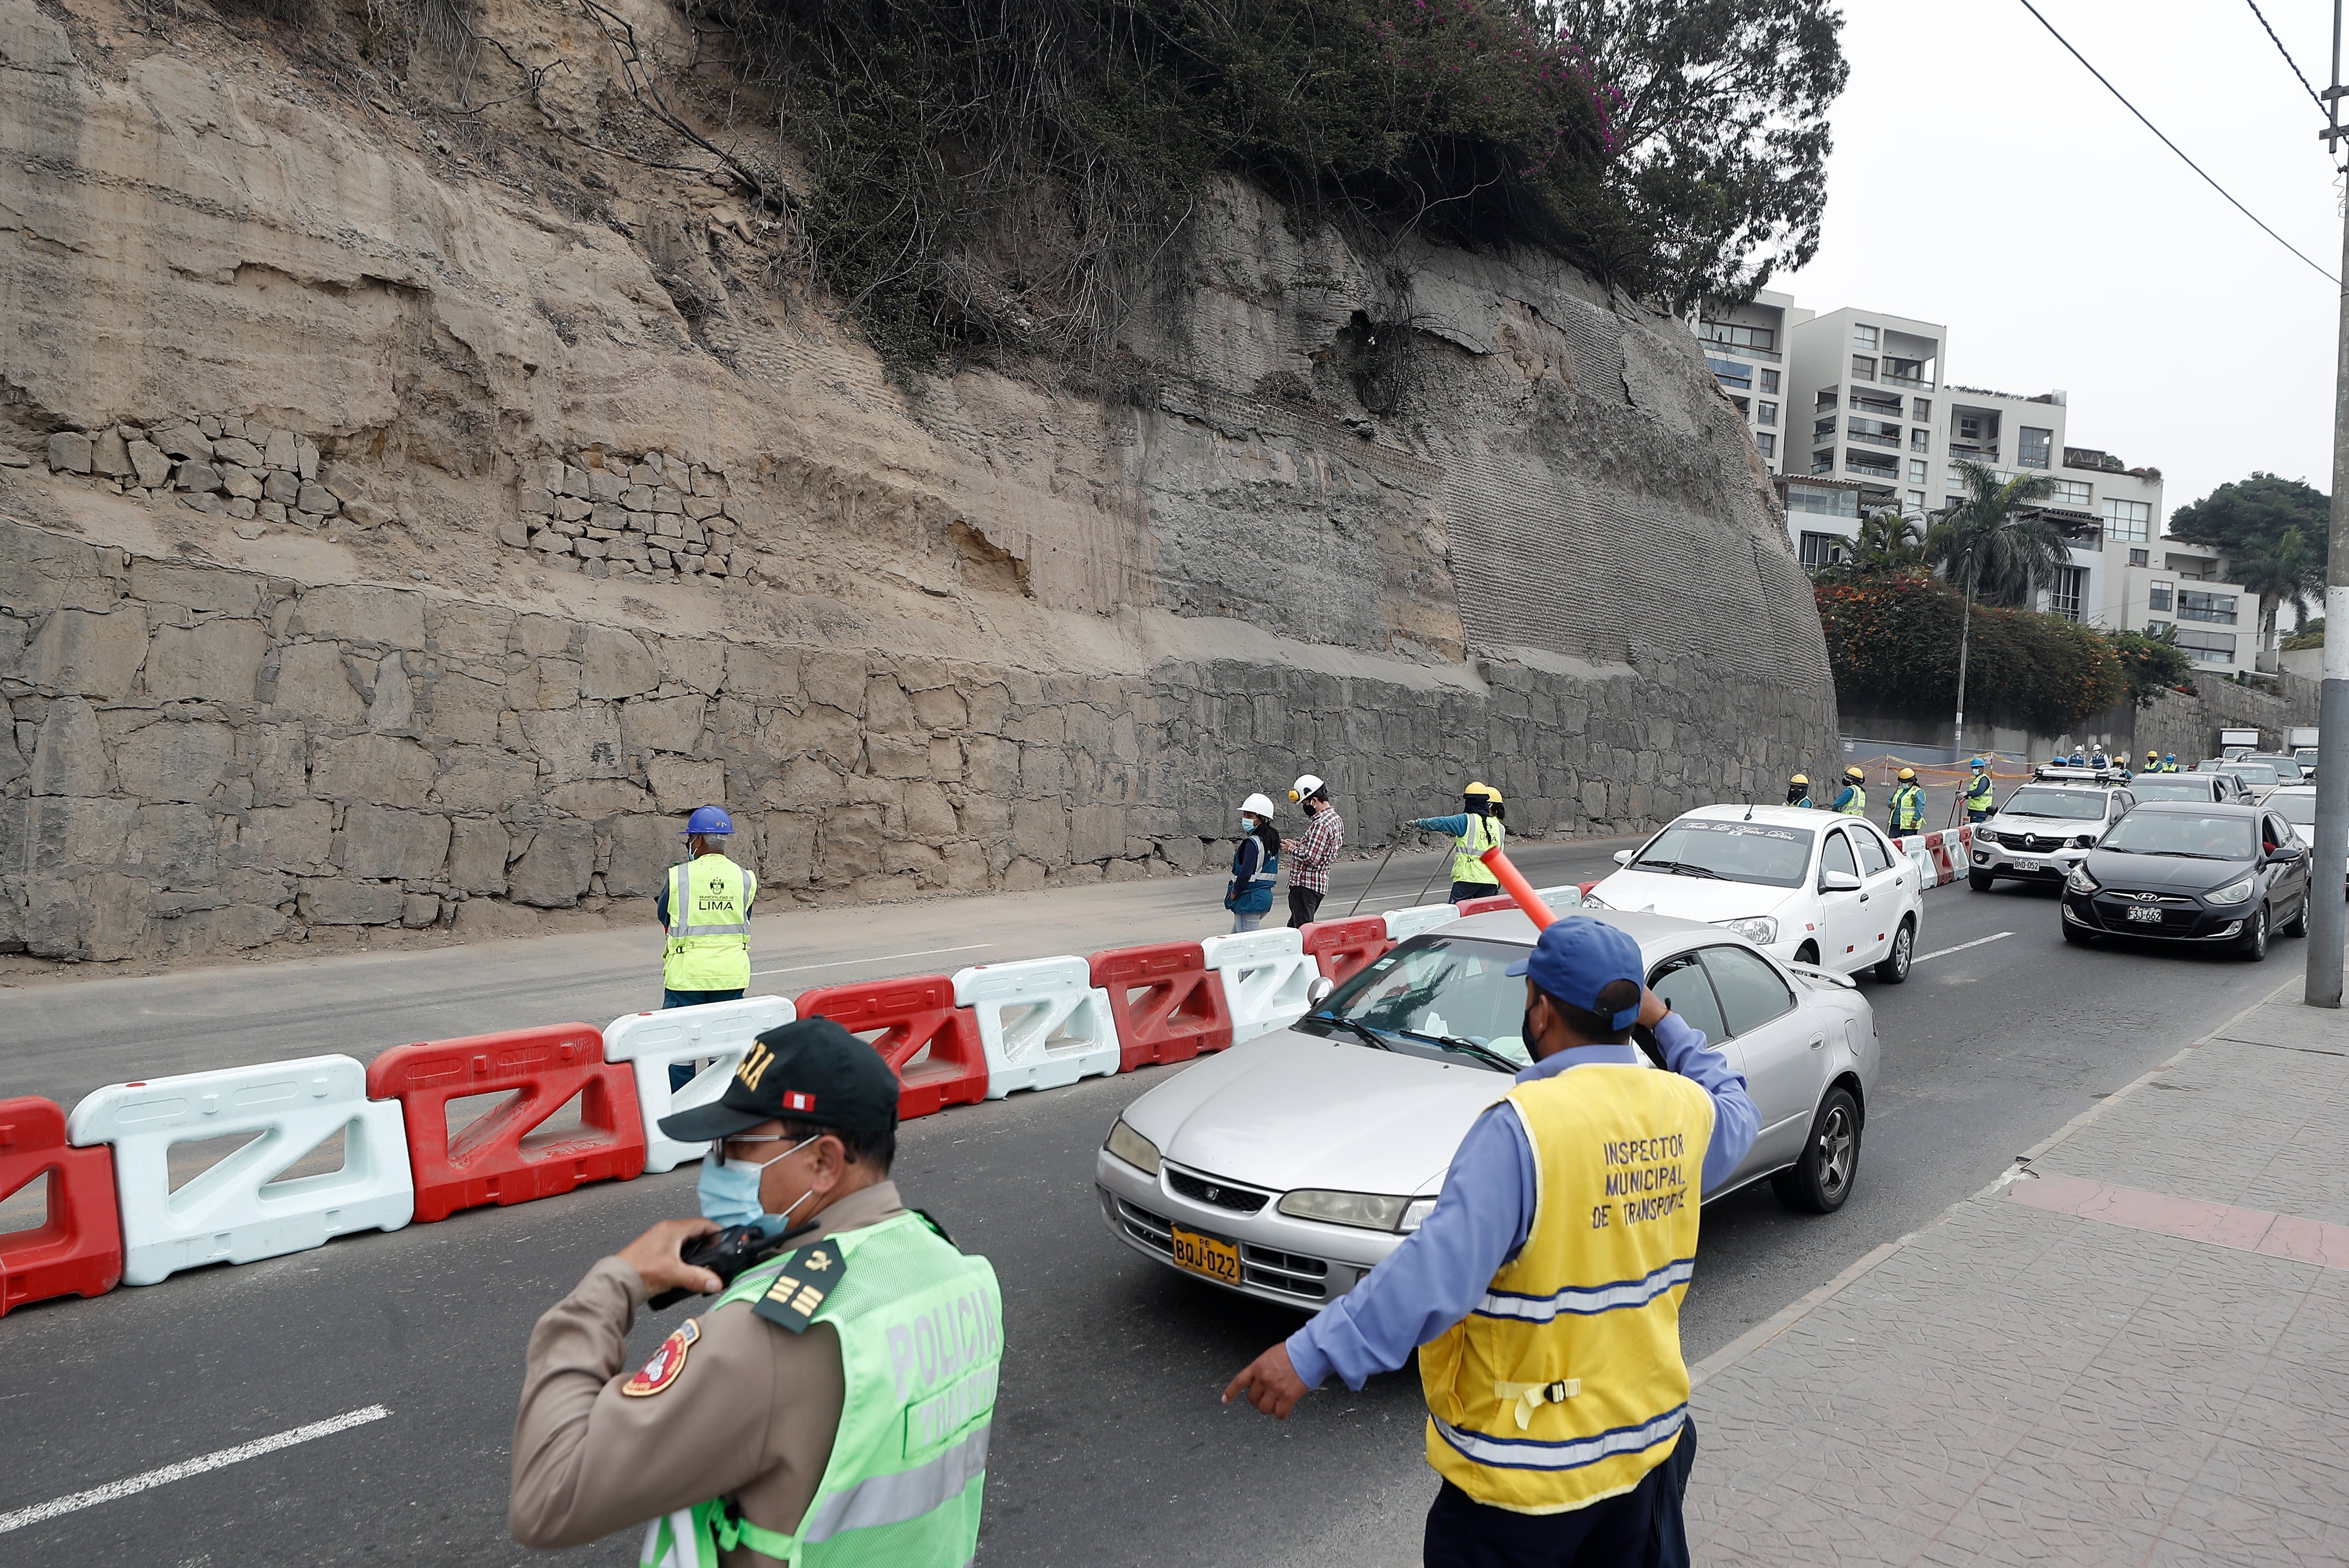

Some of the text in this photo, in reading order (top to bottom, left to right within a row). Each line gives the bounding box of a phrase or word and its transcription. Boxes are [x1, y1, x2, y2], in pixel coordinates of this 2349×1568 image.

[1765, 831, 1796, 840] Dios
[2015, 861, 2038, 869] BND-052
[699, 901, 734, 910] LIMA
[2128, 909, 2161, 921] F3J-662
[1603, 1133, 1684, 1165] INSPECTOR
[1605, 1163, 1686, 1196] MUNICIPAL
[1593, 1204, 1611, 1229] DE
[886, 1288, 1000, 1402] POLICIA
